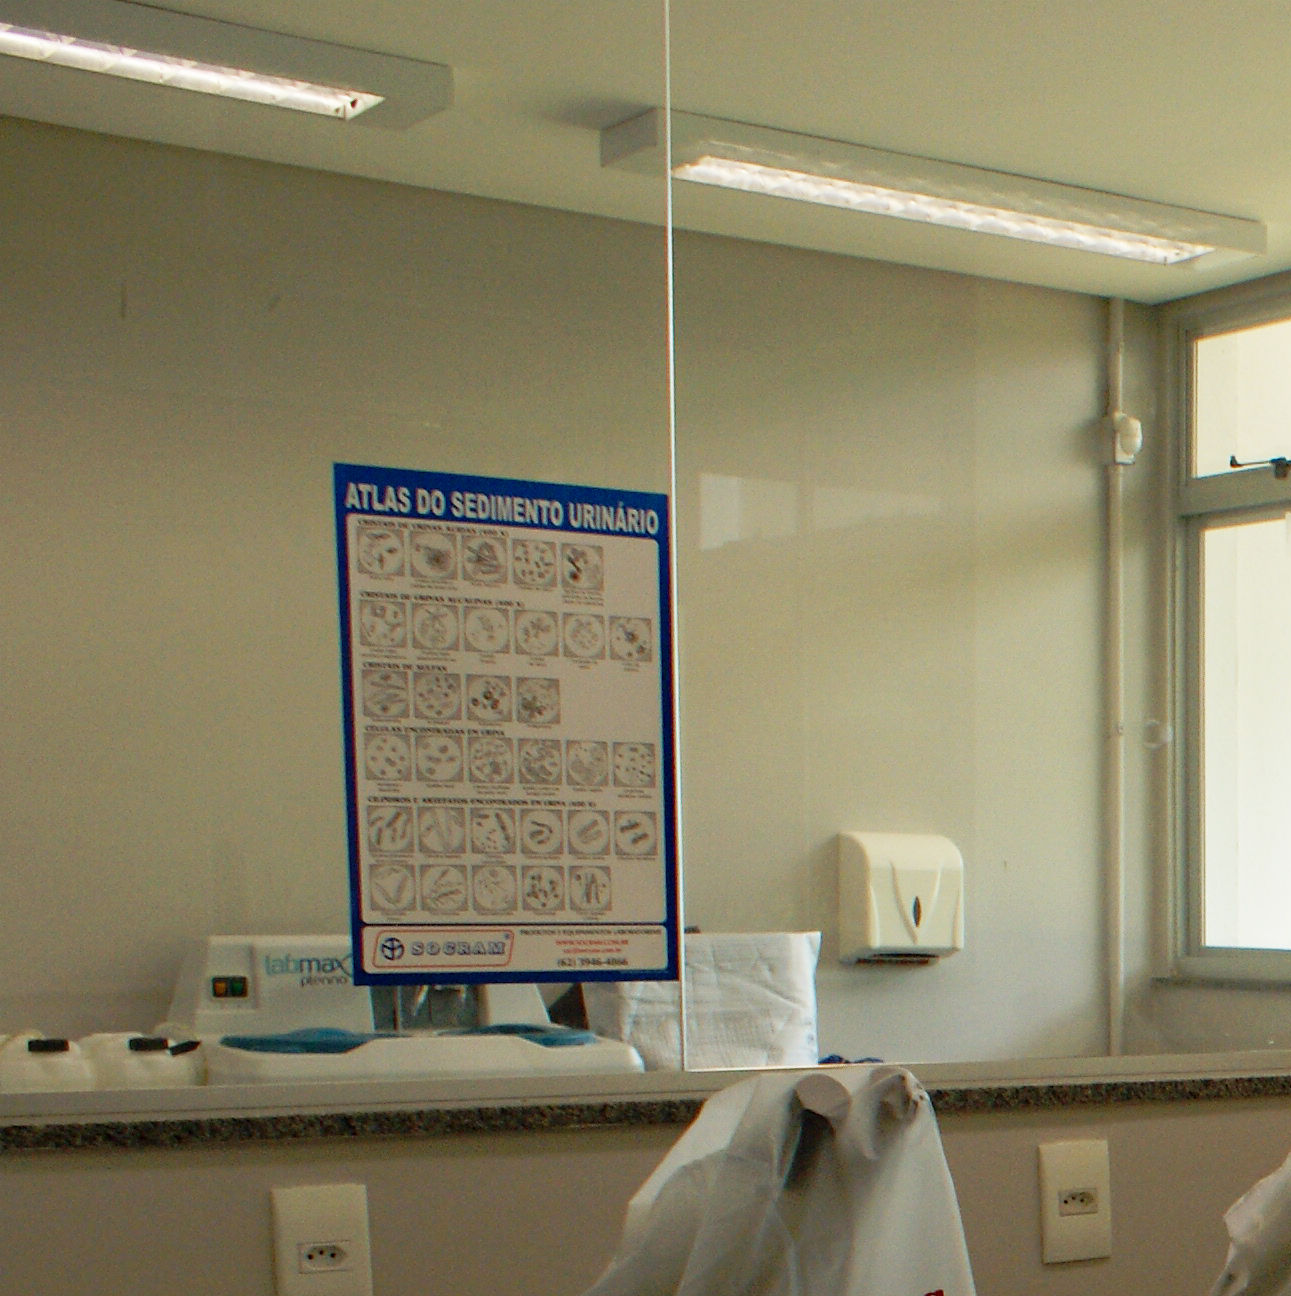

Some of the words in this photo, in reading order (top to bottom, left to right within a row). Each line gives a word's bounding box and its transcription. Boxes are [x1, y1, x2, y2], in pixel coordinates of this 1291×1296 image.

[346, 482, 411, 513] ATLAS
[416, 488, 445, 516] DO
[451, 491, 563, 526] SEDIMENTO
[568, 501, 659, 535] URINÁRIO
[410, 941, 506, 957] SOCRAM
